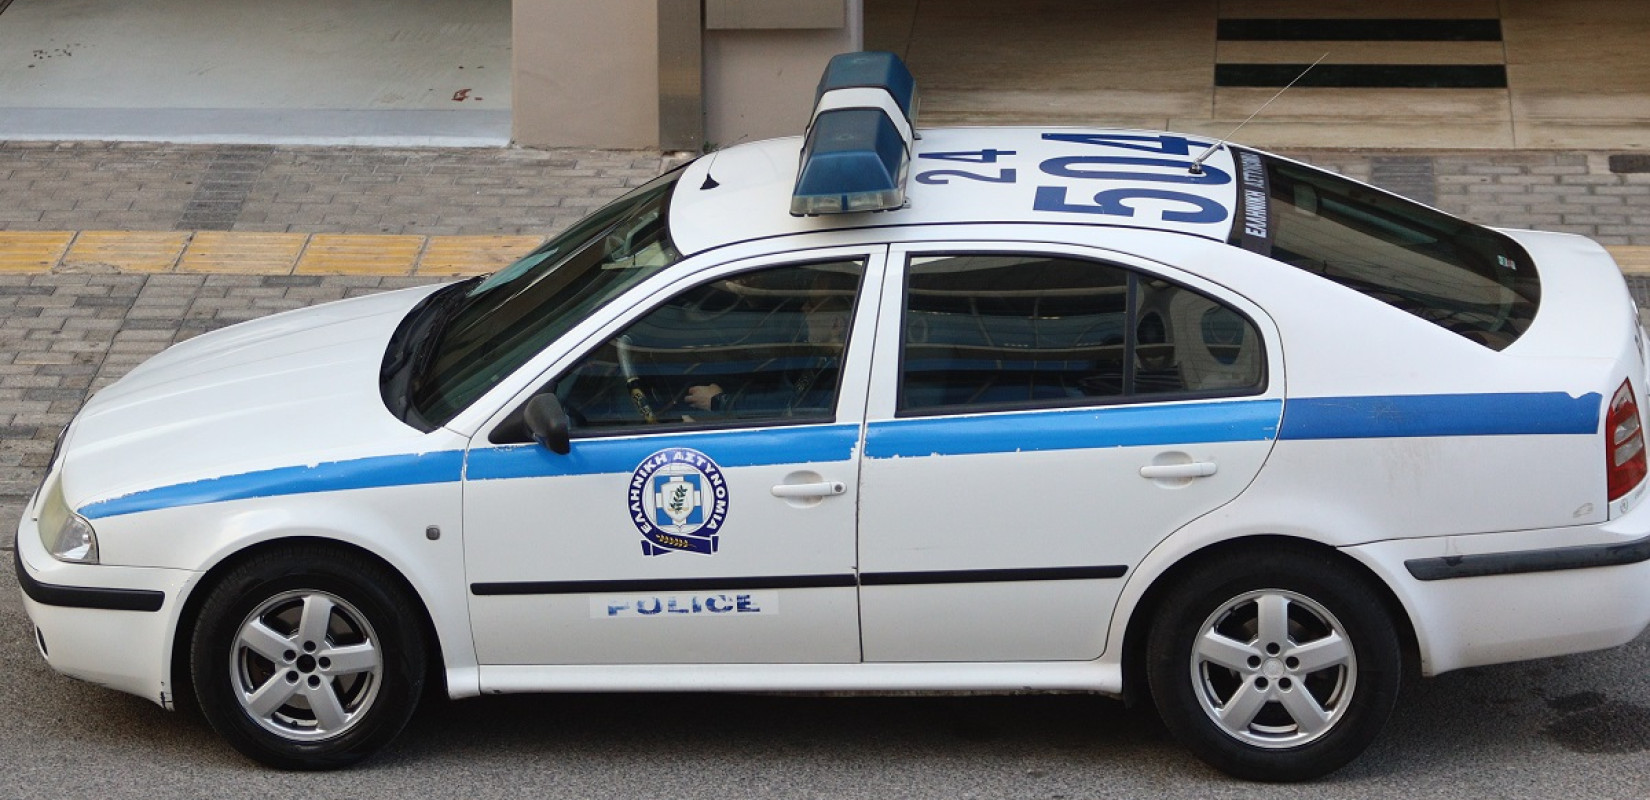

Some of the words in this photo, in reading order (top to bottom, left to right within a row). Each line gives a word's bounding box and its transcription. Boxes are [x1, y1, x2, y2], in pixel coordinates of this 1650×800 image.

[915, 148, 1017, 185] 24
[1032, 132, 1232, 224] 504
[630, 452, 668, 534] ΕΛΛΗΝΙΚΗ
[673, 451, 727, 530] ΑΣΤΥΝΟΜΙΑ
